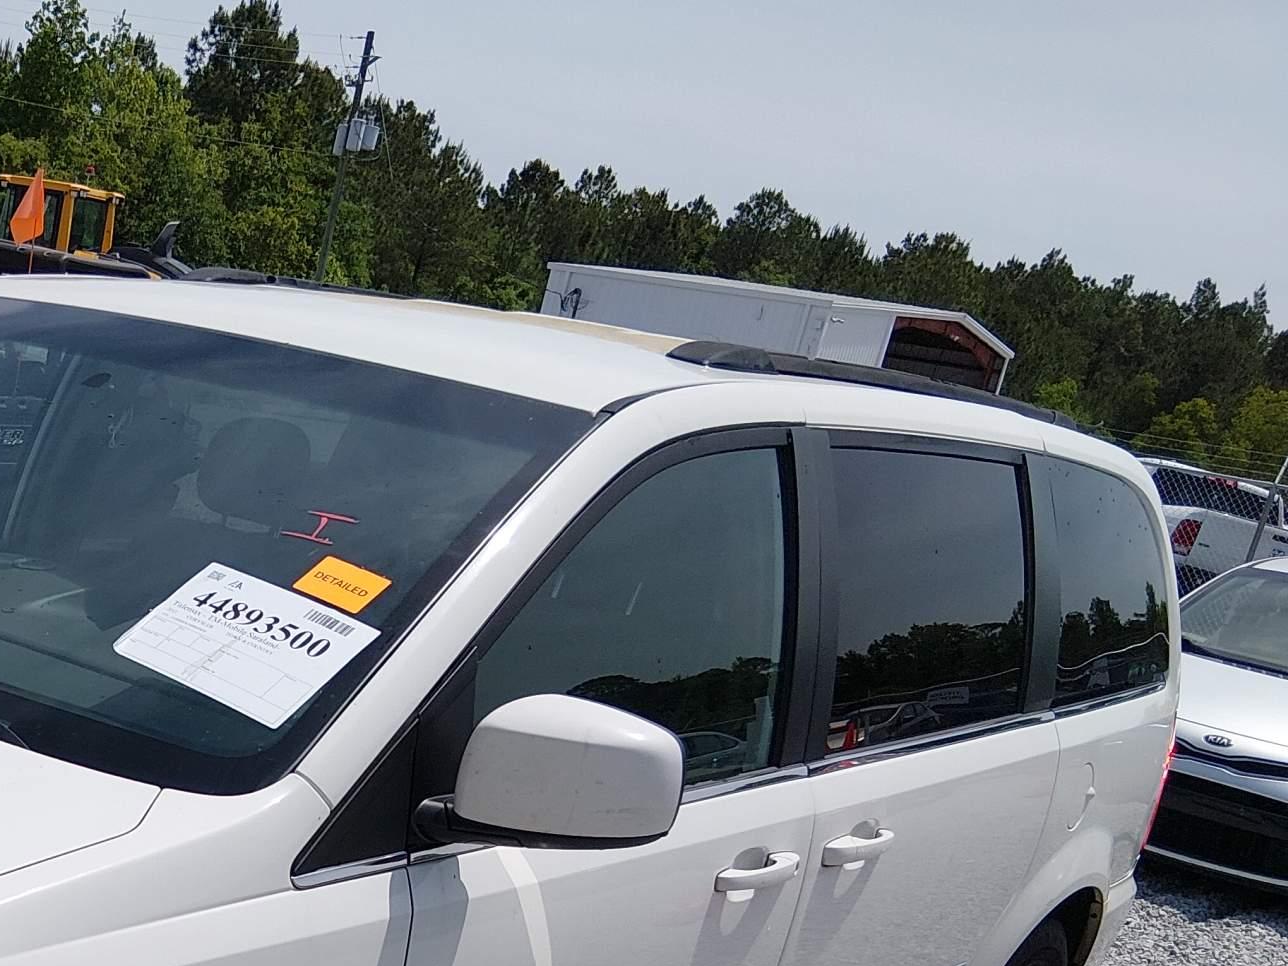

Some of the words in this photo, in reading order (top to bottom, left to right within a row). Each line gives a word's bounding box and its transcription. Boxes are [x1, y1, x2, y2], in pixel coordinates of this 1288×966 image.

[313, 571, 369, 598] DETAILED
[192, 591, 331, 658] 44893500
[1206, 735, 1230, 747] KIA
